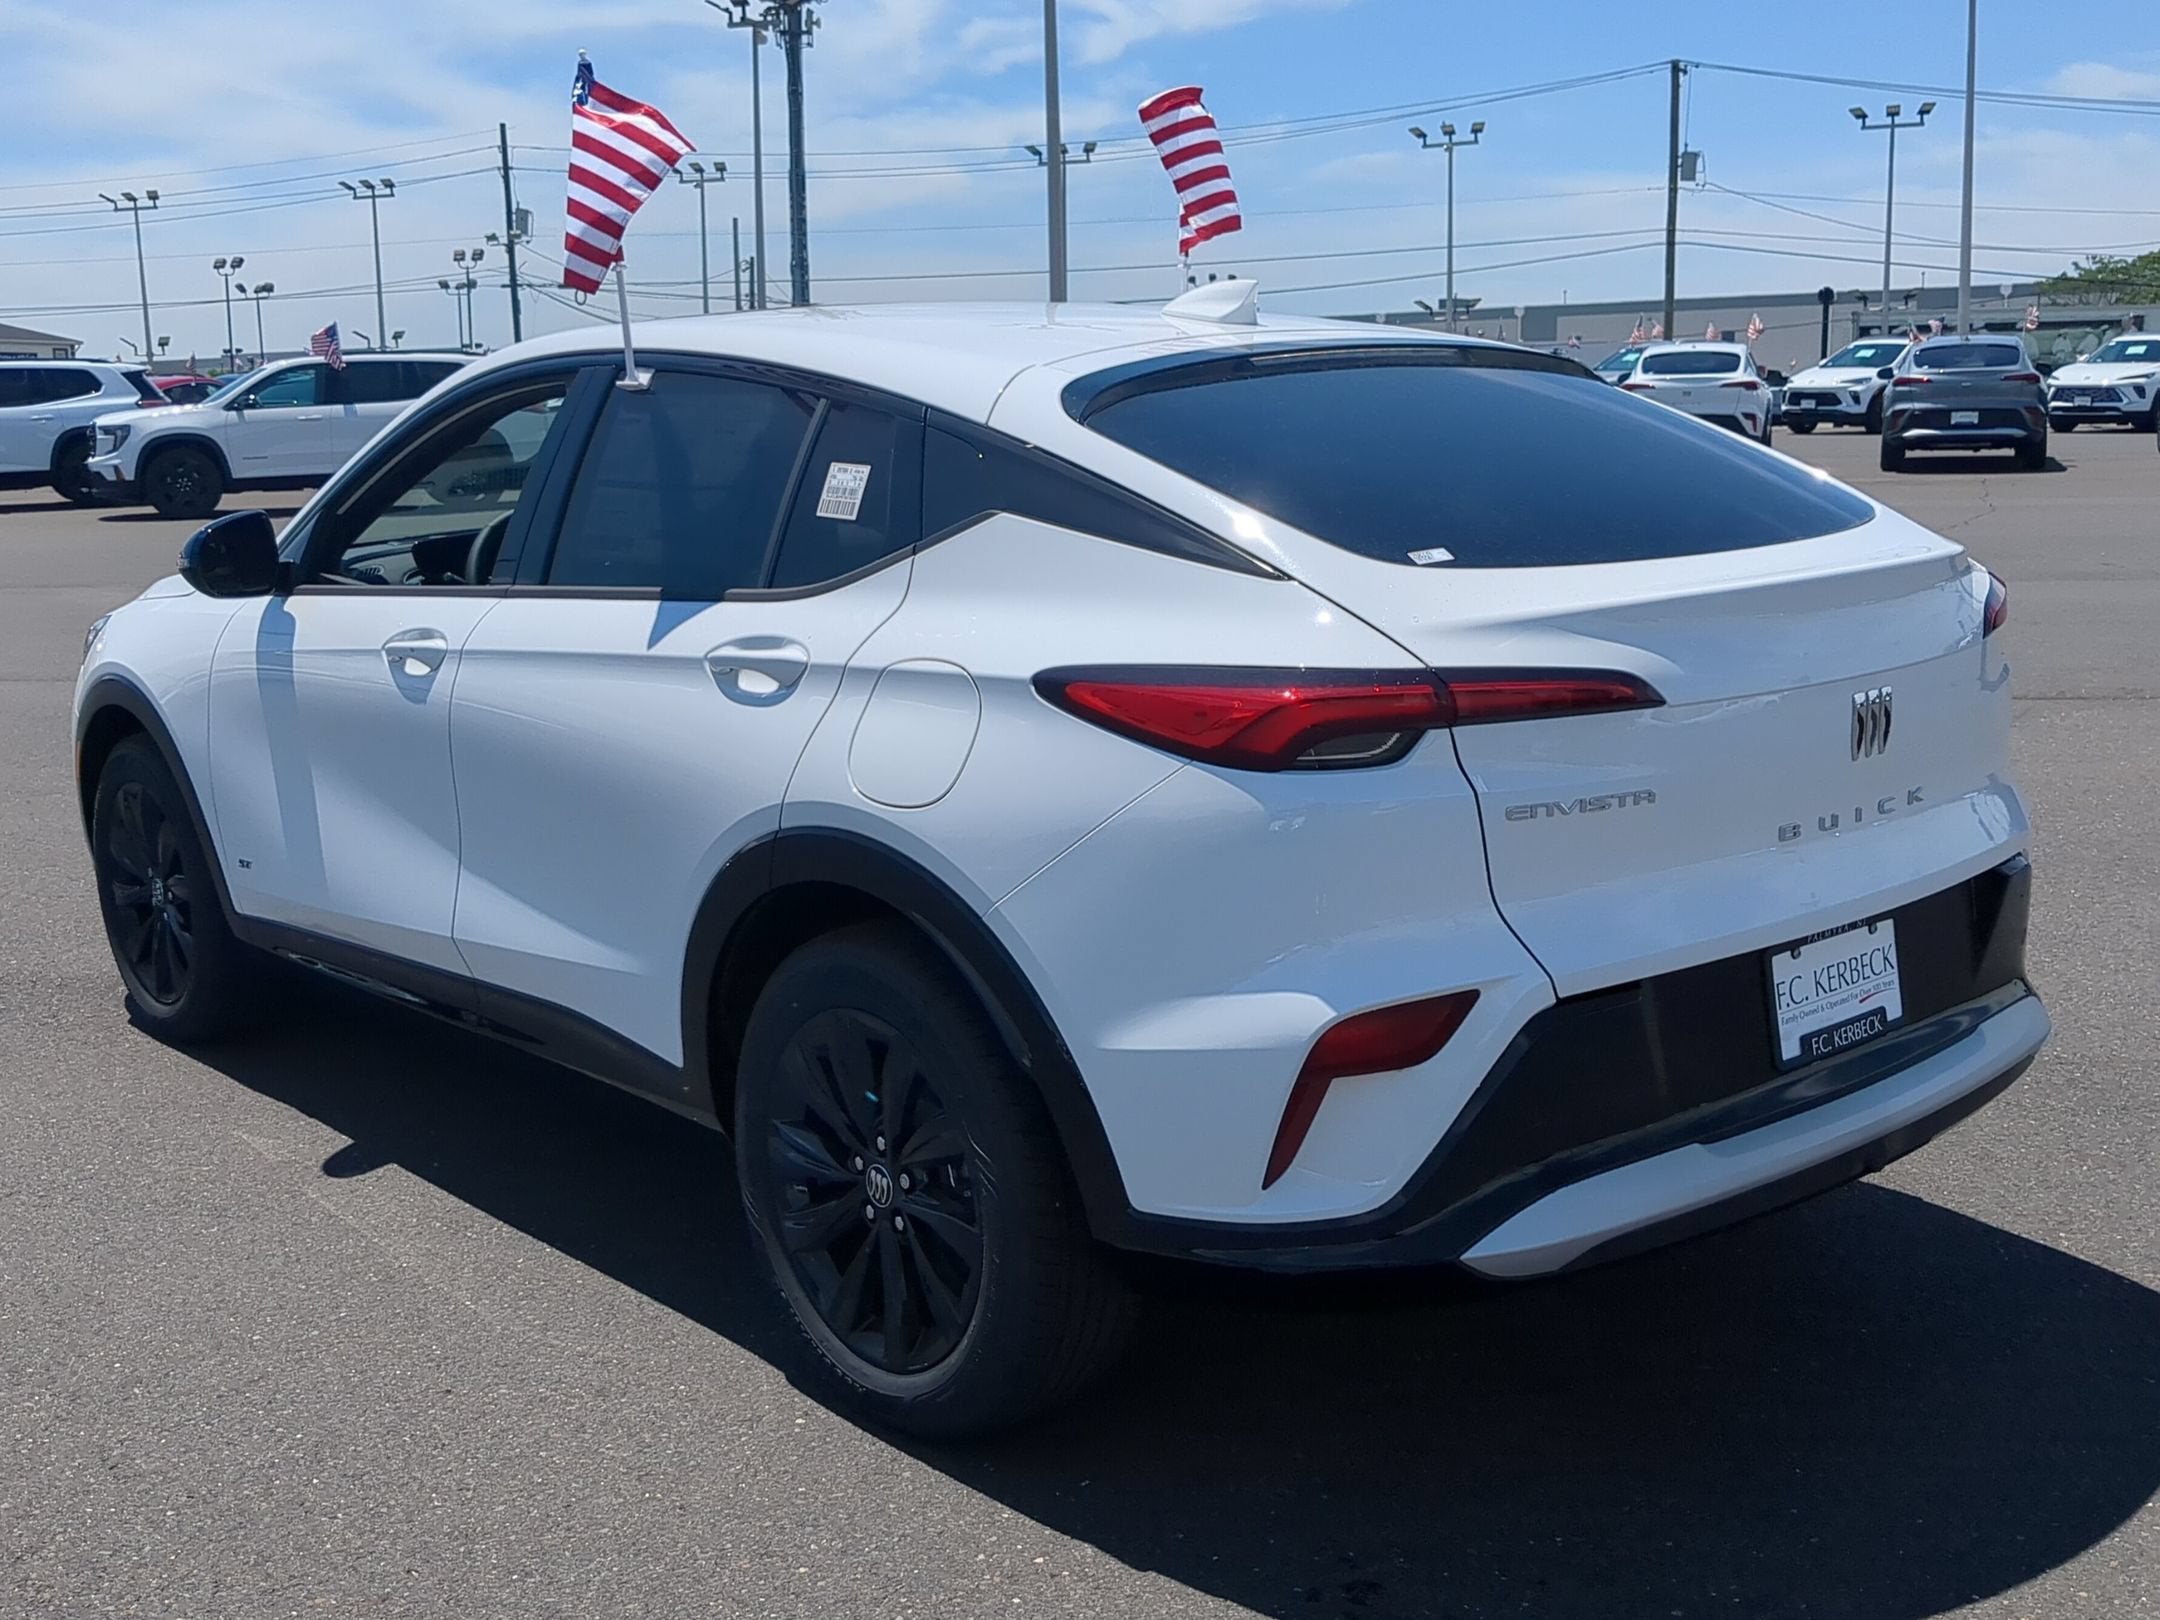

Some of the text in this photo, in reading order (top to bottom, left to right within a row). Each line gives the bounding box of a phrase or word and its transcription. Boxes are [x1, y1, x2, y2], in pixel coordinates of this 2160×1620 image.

[1505, 789, 1657, 822] ENVISTA
[1778, 786, 1926, 842] BUICK
[1776, 943, 1896, 1011] F.C. KERBECK
[1799, 1003, 1820, 1020] Owned
[1811, 1013, 1884, 1056] F.C. KERBECK
